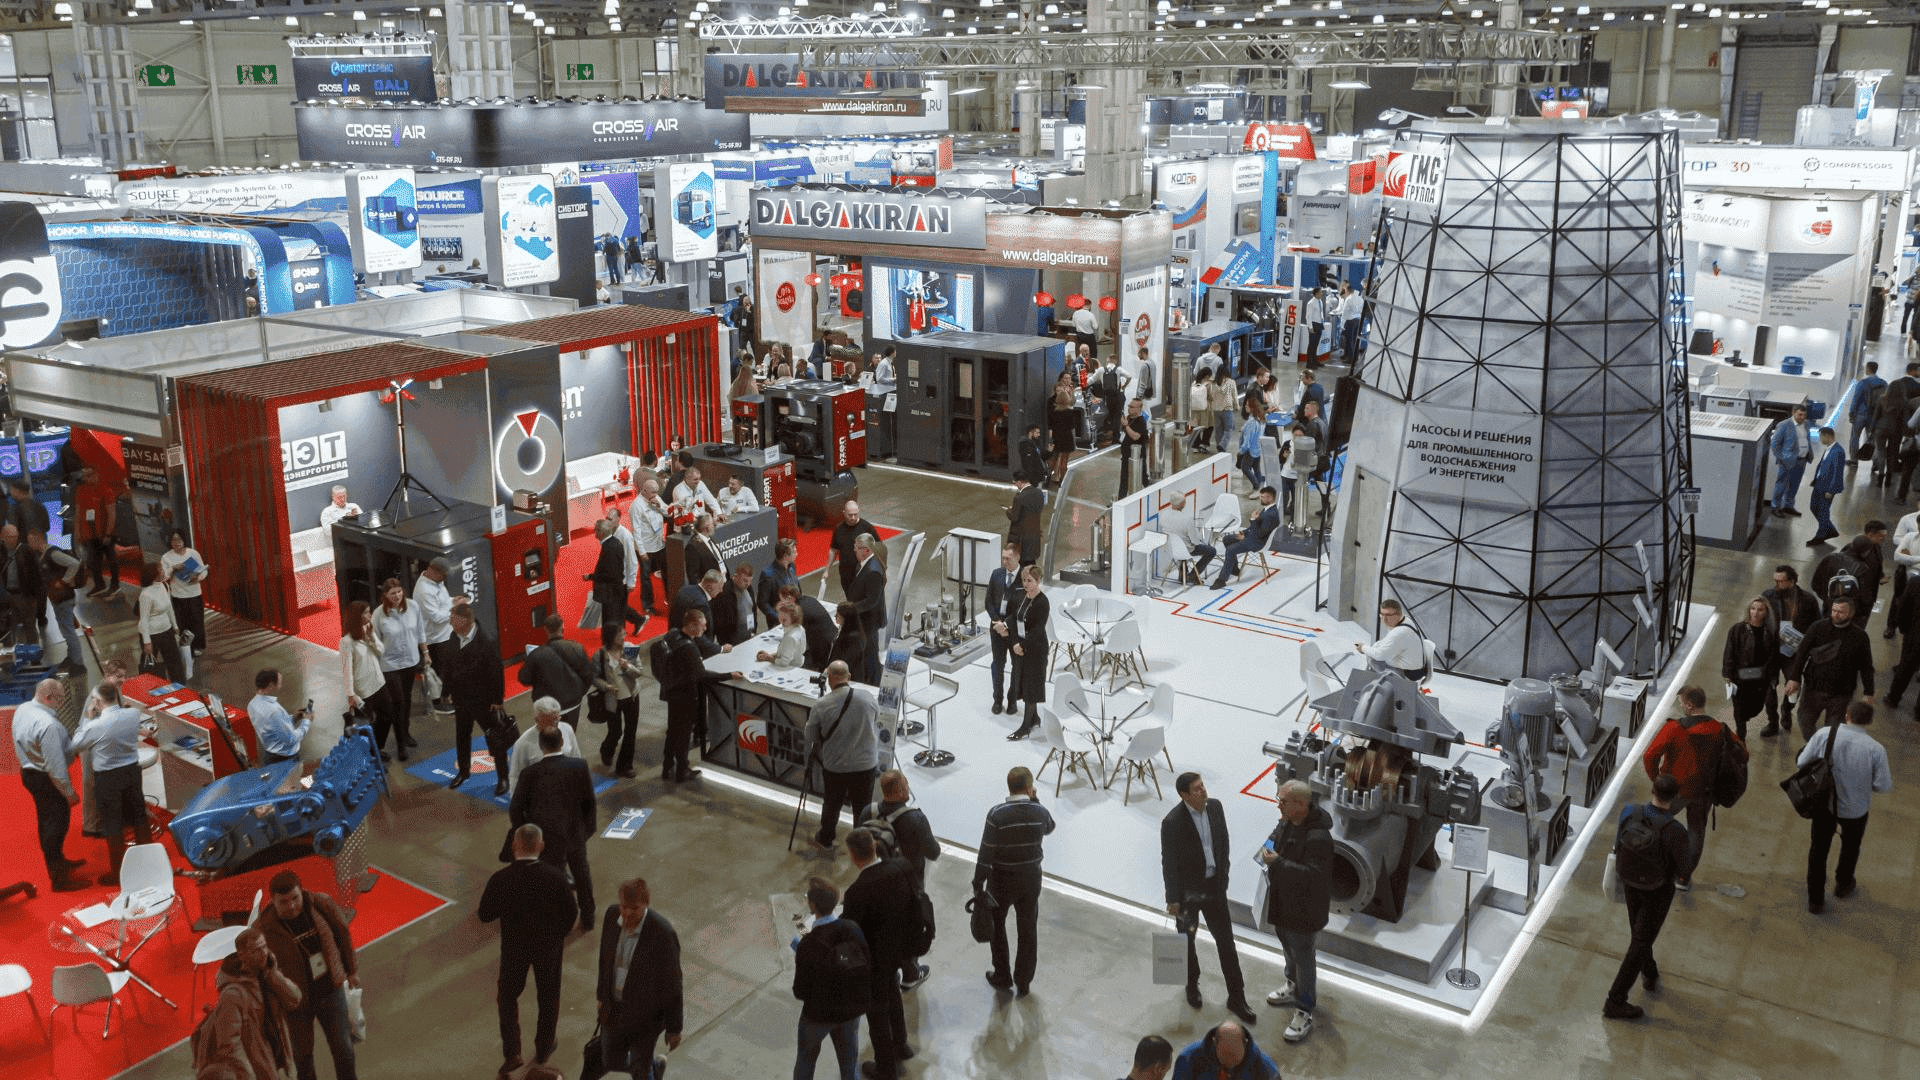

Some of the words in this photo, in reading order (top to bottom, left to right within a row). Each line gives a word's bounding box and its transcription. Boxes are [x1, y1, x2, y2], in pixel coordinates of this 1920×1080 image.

[318, 83, 342, 93] CROSS
[348, 83, 361, 92] AIR
[822, 100, 907, 113] www.dalgakiran.ru
[926, 99, 943, 112] .RU
[345, 124, 392, 138] CROSS
[402, 125, 426, 139] AIR
[592, 119, 644, 135] CROSS
[655, 118, 679, 132] AIR
[1409, 154, 1441, 186] ГМС
[1731, 161, 1750, 178] 30
[1822, 160, 1893, 174] COMPRESSORS
[416, 190, 465, 201] SOURCE
[1406, 184, 1436, 204] ГРУППА
[756, 198, 952, 233] DALGAKIRAN
[1003, 249, 1108, 265] www.dalgakiran.ru
[1125, 276, 1162, 293] DALGAKIRN
[1411, 423, 1460, 438] НАСОСЫ
[1463, 429, 1472, 439] И
[1474, 431, 1532, 446] РЕШЕНИЯ
[1407, 439, 1428, 450] ДЛЯ
[1432, 442, 1534, 463] ПРОМЫШЛЕННОГО
[1420, 453, 1517, 473] ВОДОСНАБЖЕНИЯ
[1429, 466, 1438, 476] И
[1439, 468, 1505, 484] ЭНЕРГЕТИКИ
[722, 536, 769, 560] ПРЕССОРАХ
